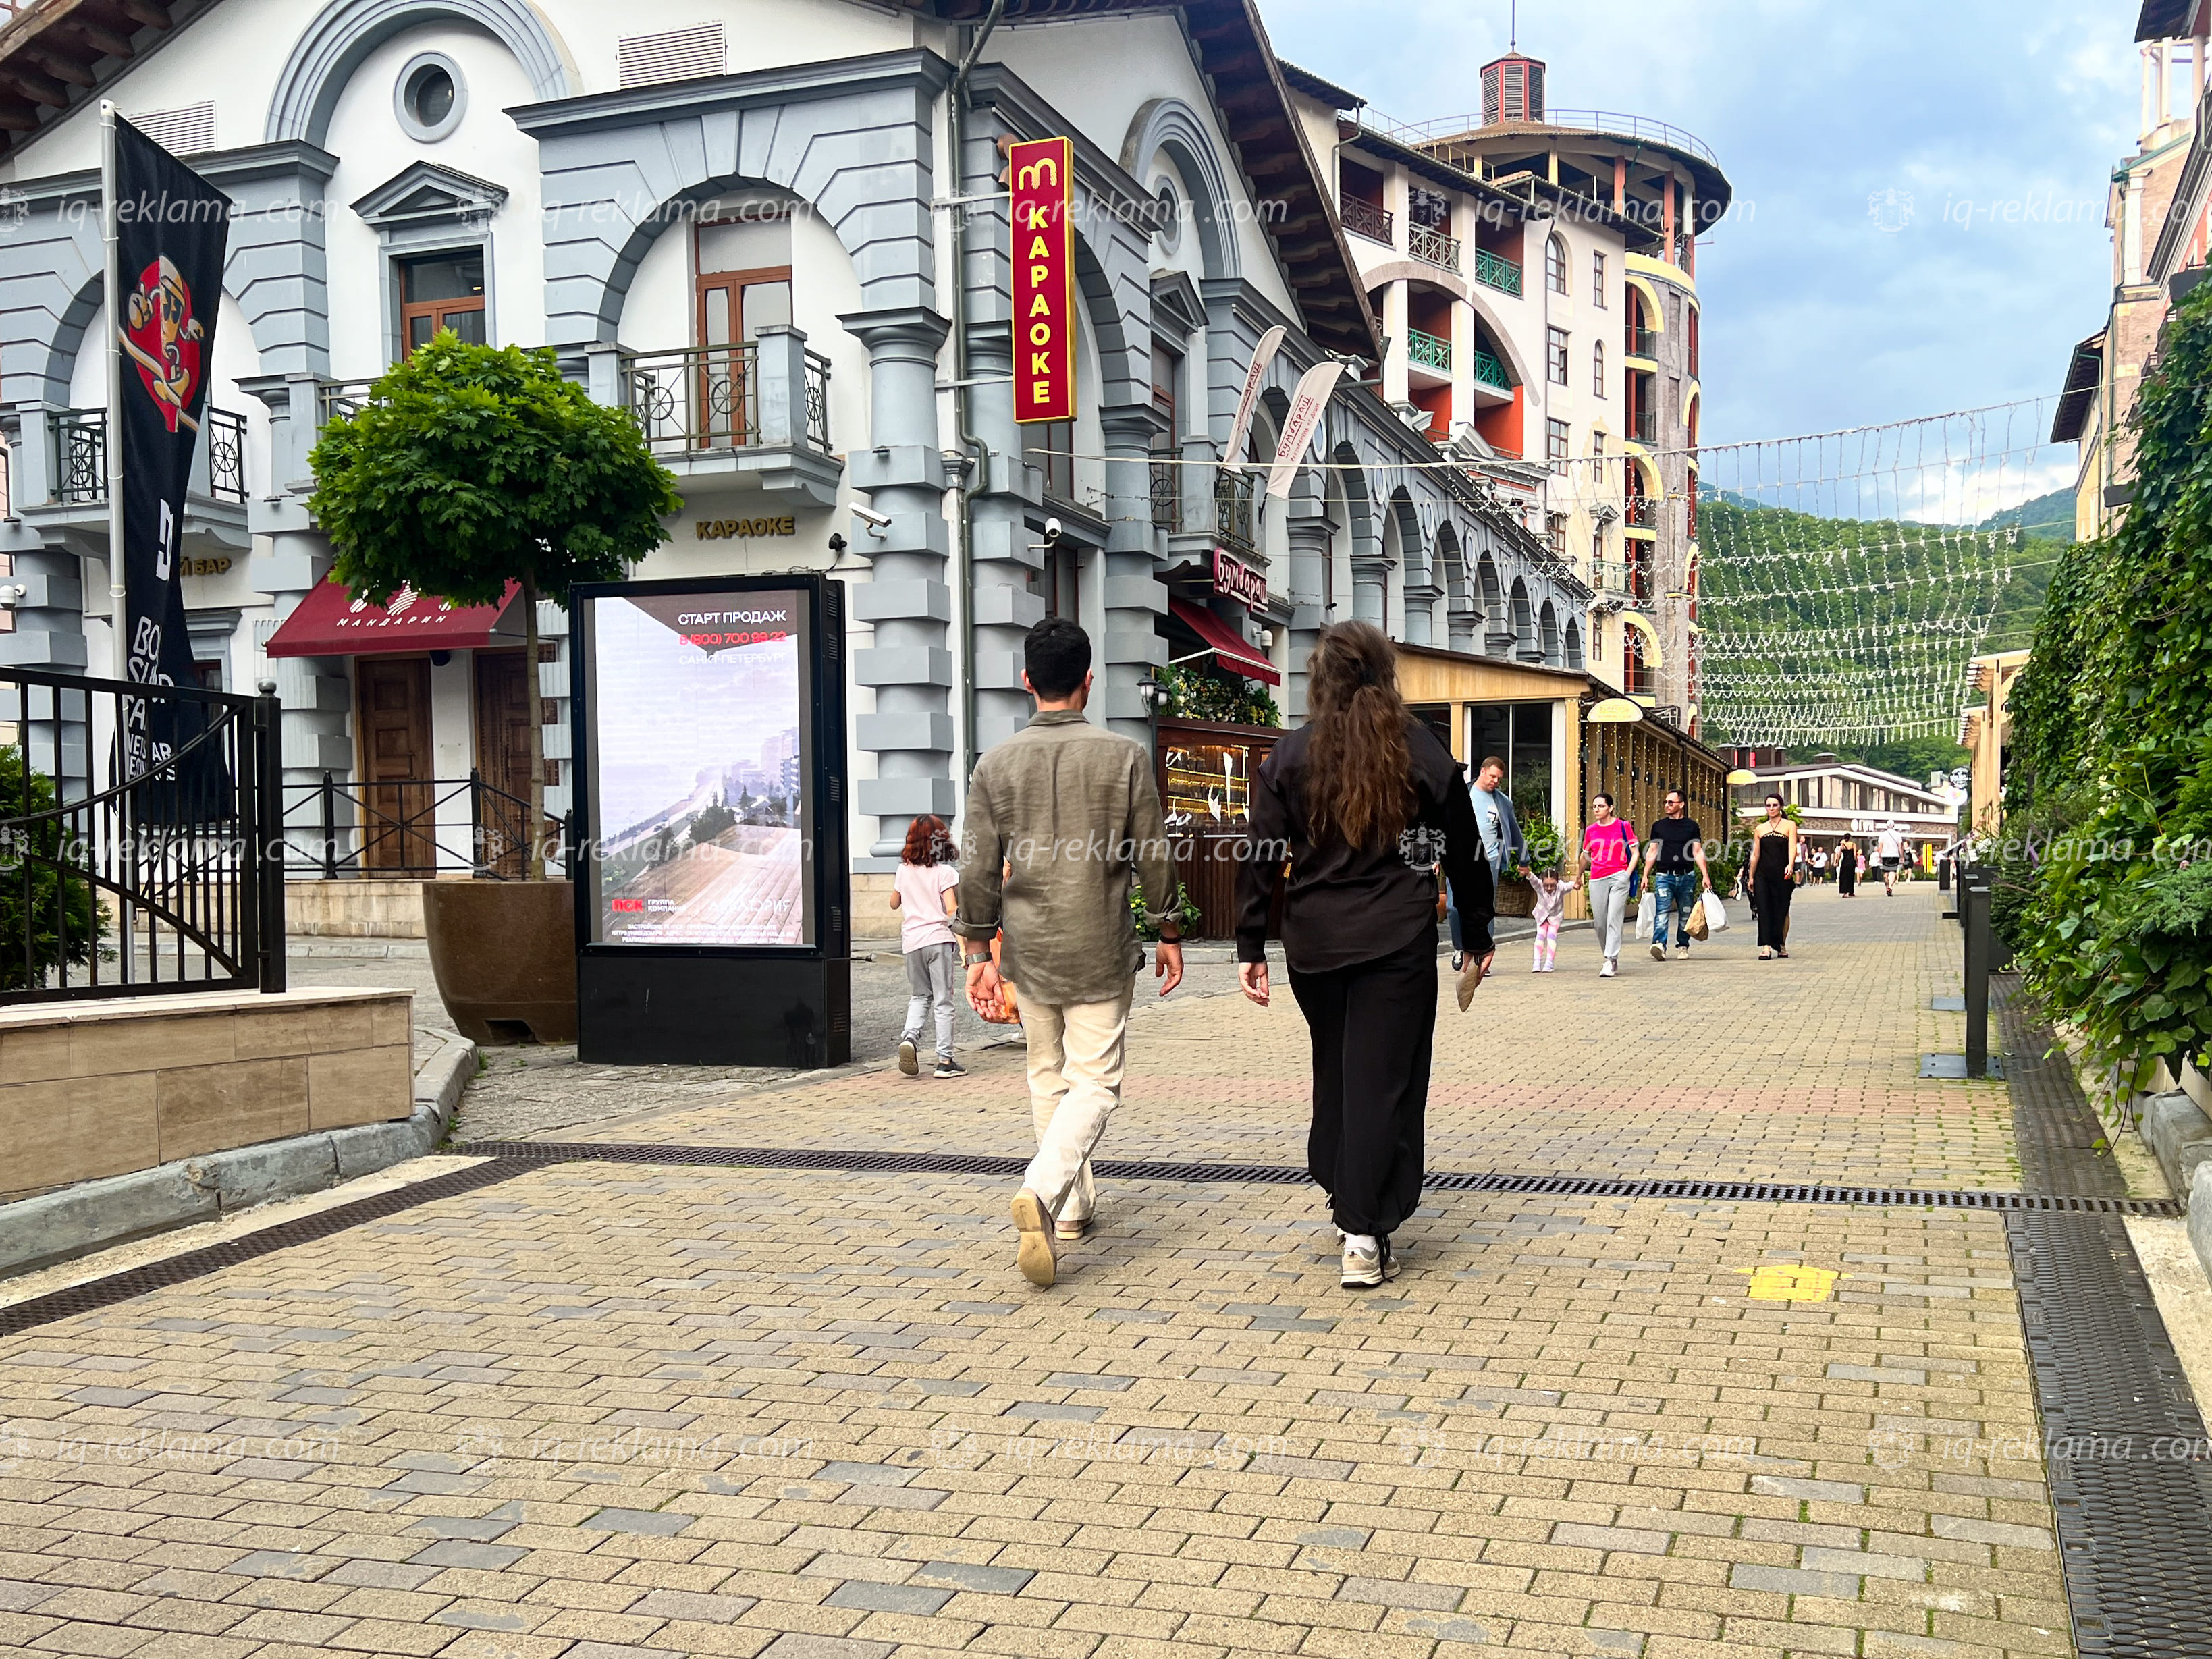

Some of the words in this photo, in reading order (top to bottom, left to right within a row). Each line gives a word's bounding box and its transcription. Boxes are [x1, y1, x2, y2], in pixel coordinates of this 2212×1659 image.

[1028, 207, 1050, 404] КАРАОКЕ
[696, 516, 796, 539] КАРАОКЕ
[194, 557, 232, 575] БАР
[337, 614, 447, 627] МАНДАРИН
[678, 612, 721, 625] СТАРТ
[722, 609, 786, 624] ПРОДАЖ
[679, 634, 689, 645] 8
[690, 633, 722, 645] (800)
[724, 632, 750, 644] 700
[751, 631, 768, 643] 99
[770, 630, 787, 642] 22
[679, 653, 786, 665] САНКТ-ПЕТЕРБУРГ
